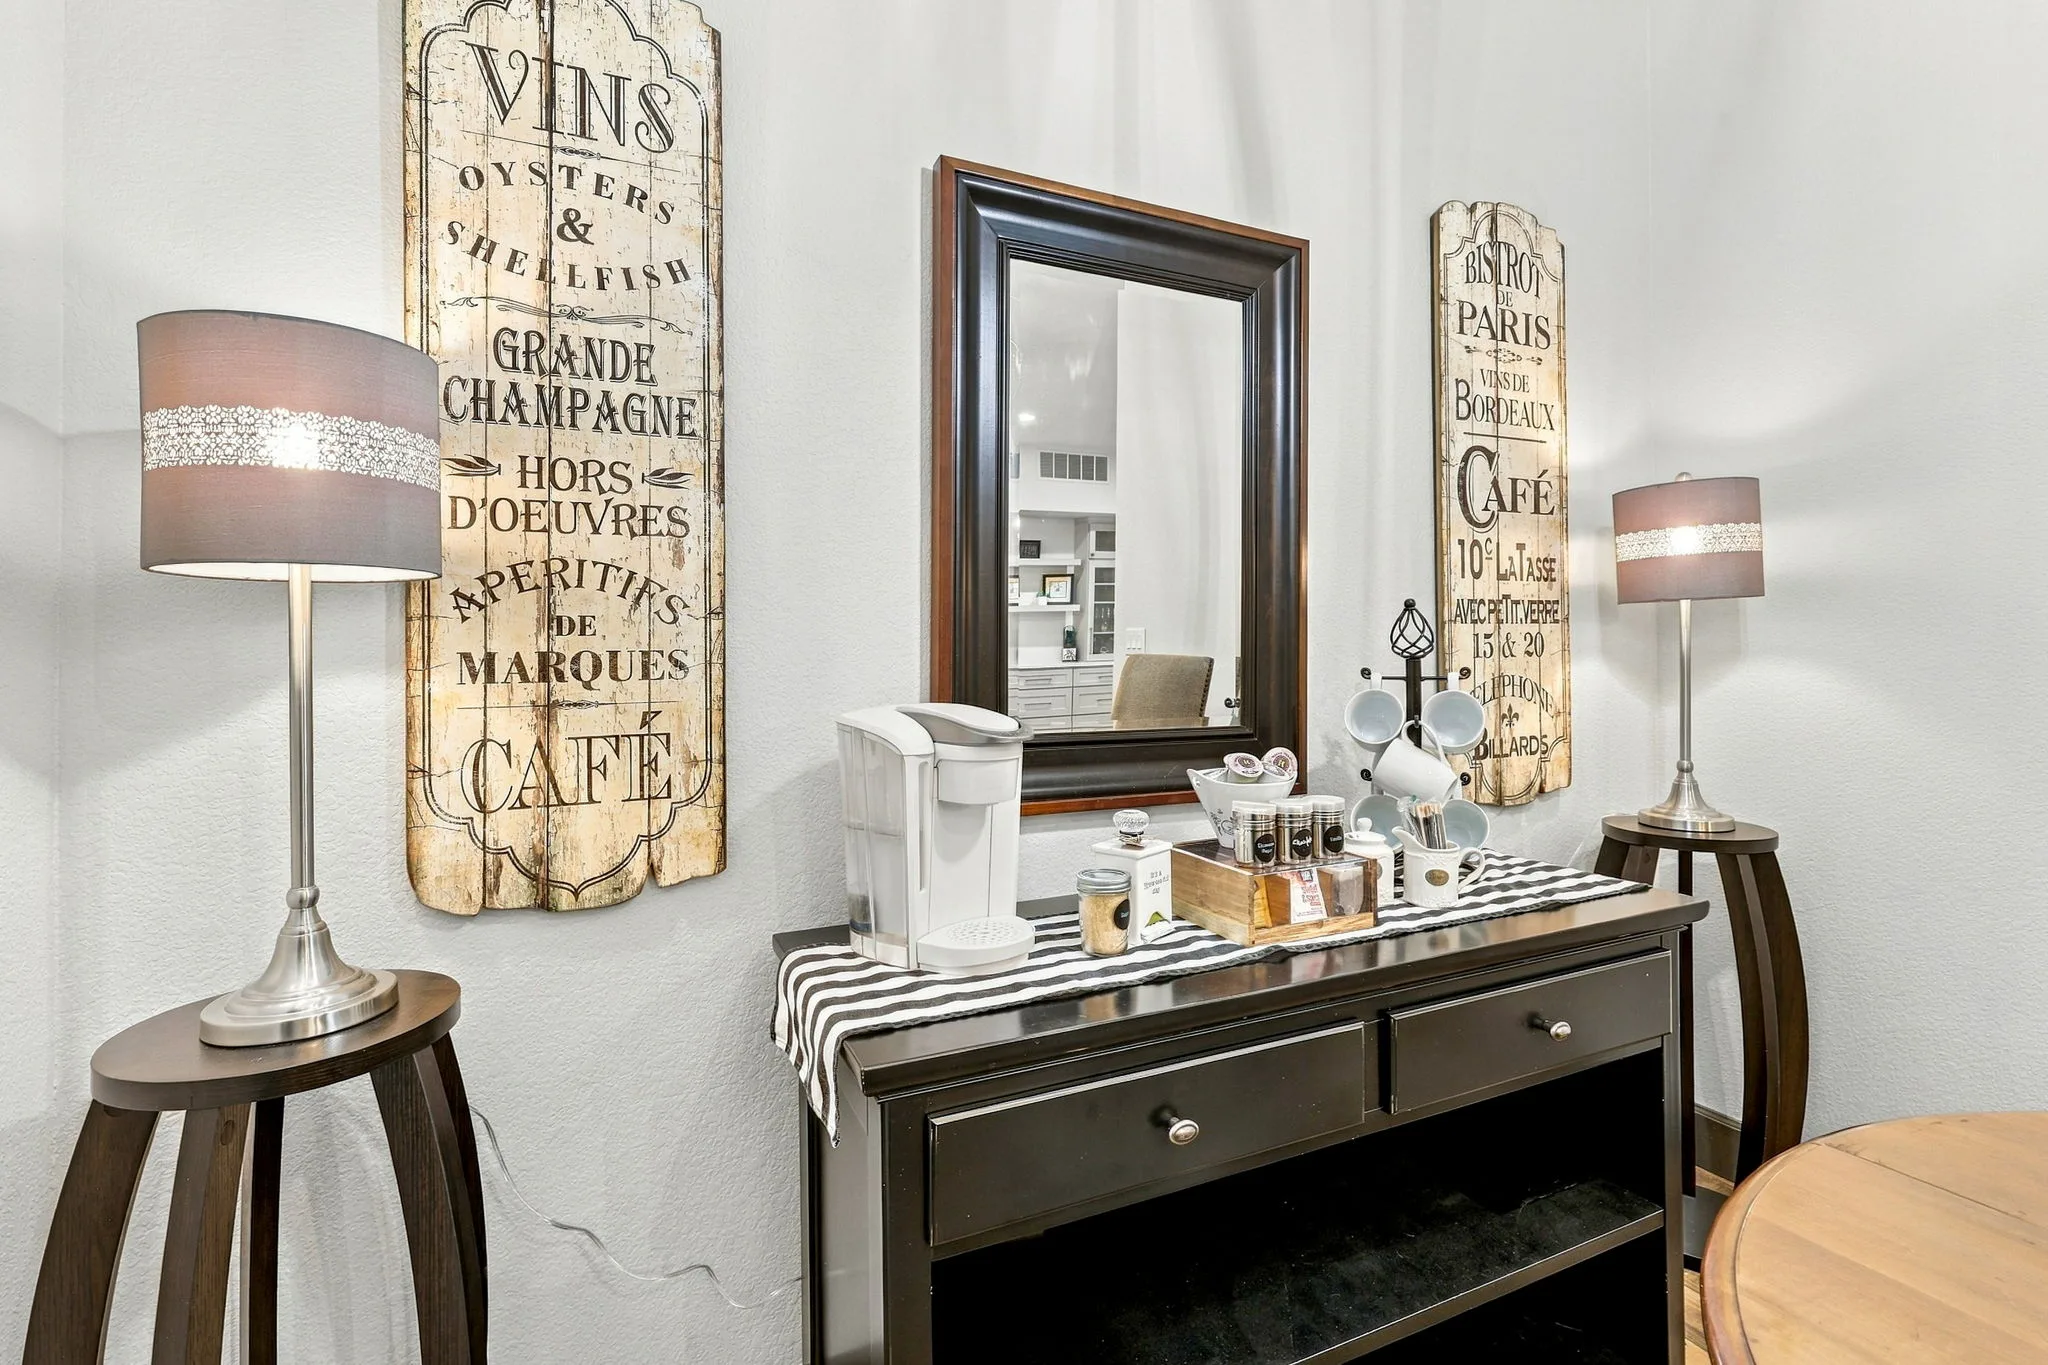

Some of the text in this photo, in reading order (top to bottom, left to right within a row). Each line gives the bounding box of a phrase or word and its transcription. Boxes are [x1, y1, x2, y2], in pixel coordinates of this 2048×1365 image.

[458, 40, 675, 153] VINS
[458, 161, 675, 225] OYSTERS
[556, 208, 595, 245] &
[443, 221, 692, 291] SHELLFISH
[1465, 241, 1544, 299] BISTROT
[1497, 289, 1513, 307] DE
[1456, 299, 1551, 350] PARIS
[493, 327, 658, 387] GRANDE
[1480, 368, 1530, 393] VINS DE
[443, 375, 699, 440] CHAMPAGNE
[1455, 378, 1555, 431] BORDEAUX
[518, 455, 634, 495] HORS
[447, 495, 692, 541] D'OEUVRES
[449, 557, 690, 626] APERITIFS
[1454, 598, 1487, 625] AVEC
[555, 614, 597, 637] DE
[1473, 631, 1545, 659] 15 & 20
[456, 650, 689, 691] MARQUES
[459, 711, 673, 814] CAFÉ
[1473, 728, 1549, 761] BILLARDS
